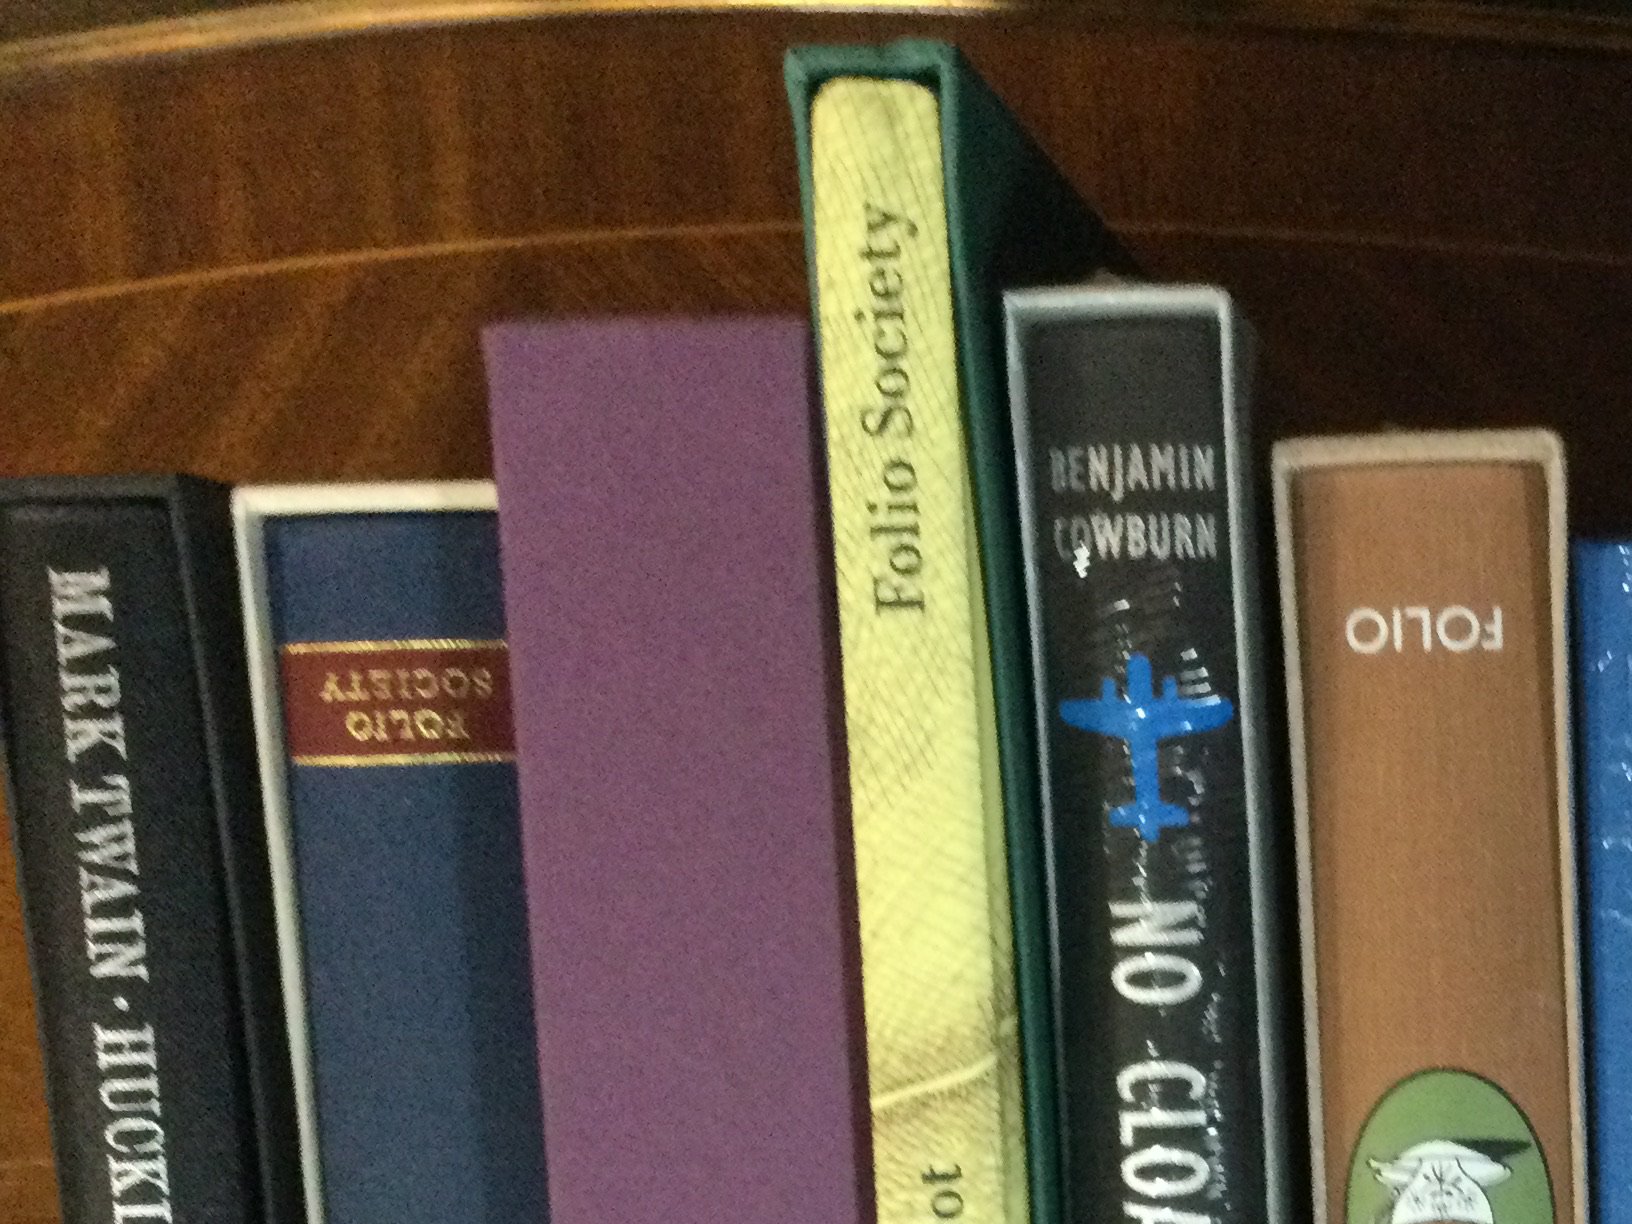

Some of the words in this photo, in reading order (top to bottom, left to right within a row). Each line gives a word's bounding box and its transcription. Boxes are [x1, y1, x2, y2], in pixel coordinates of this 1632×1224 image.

[855, 202, 919, 440] Society
[1050, 443, 1215, 502] BENJAMIN
[867, 458, 926, 616] Folio
[1053, 512, 1218, 562] COWBURN
[47, 564, 127, 762] MARK
[1345, 605, 1503, 654] FOLIO
[319, 666, 493, 704] SOCIETY
[344, 707, 470, 742] FOLIO
[70, 772, 151, 985] TWAIN
[1108, 899, 1204, 1006] NO
